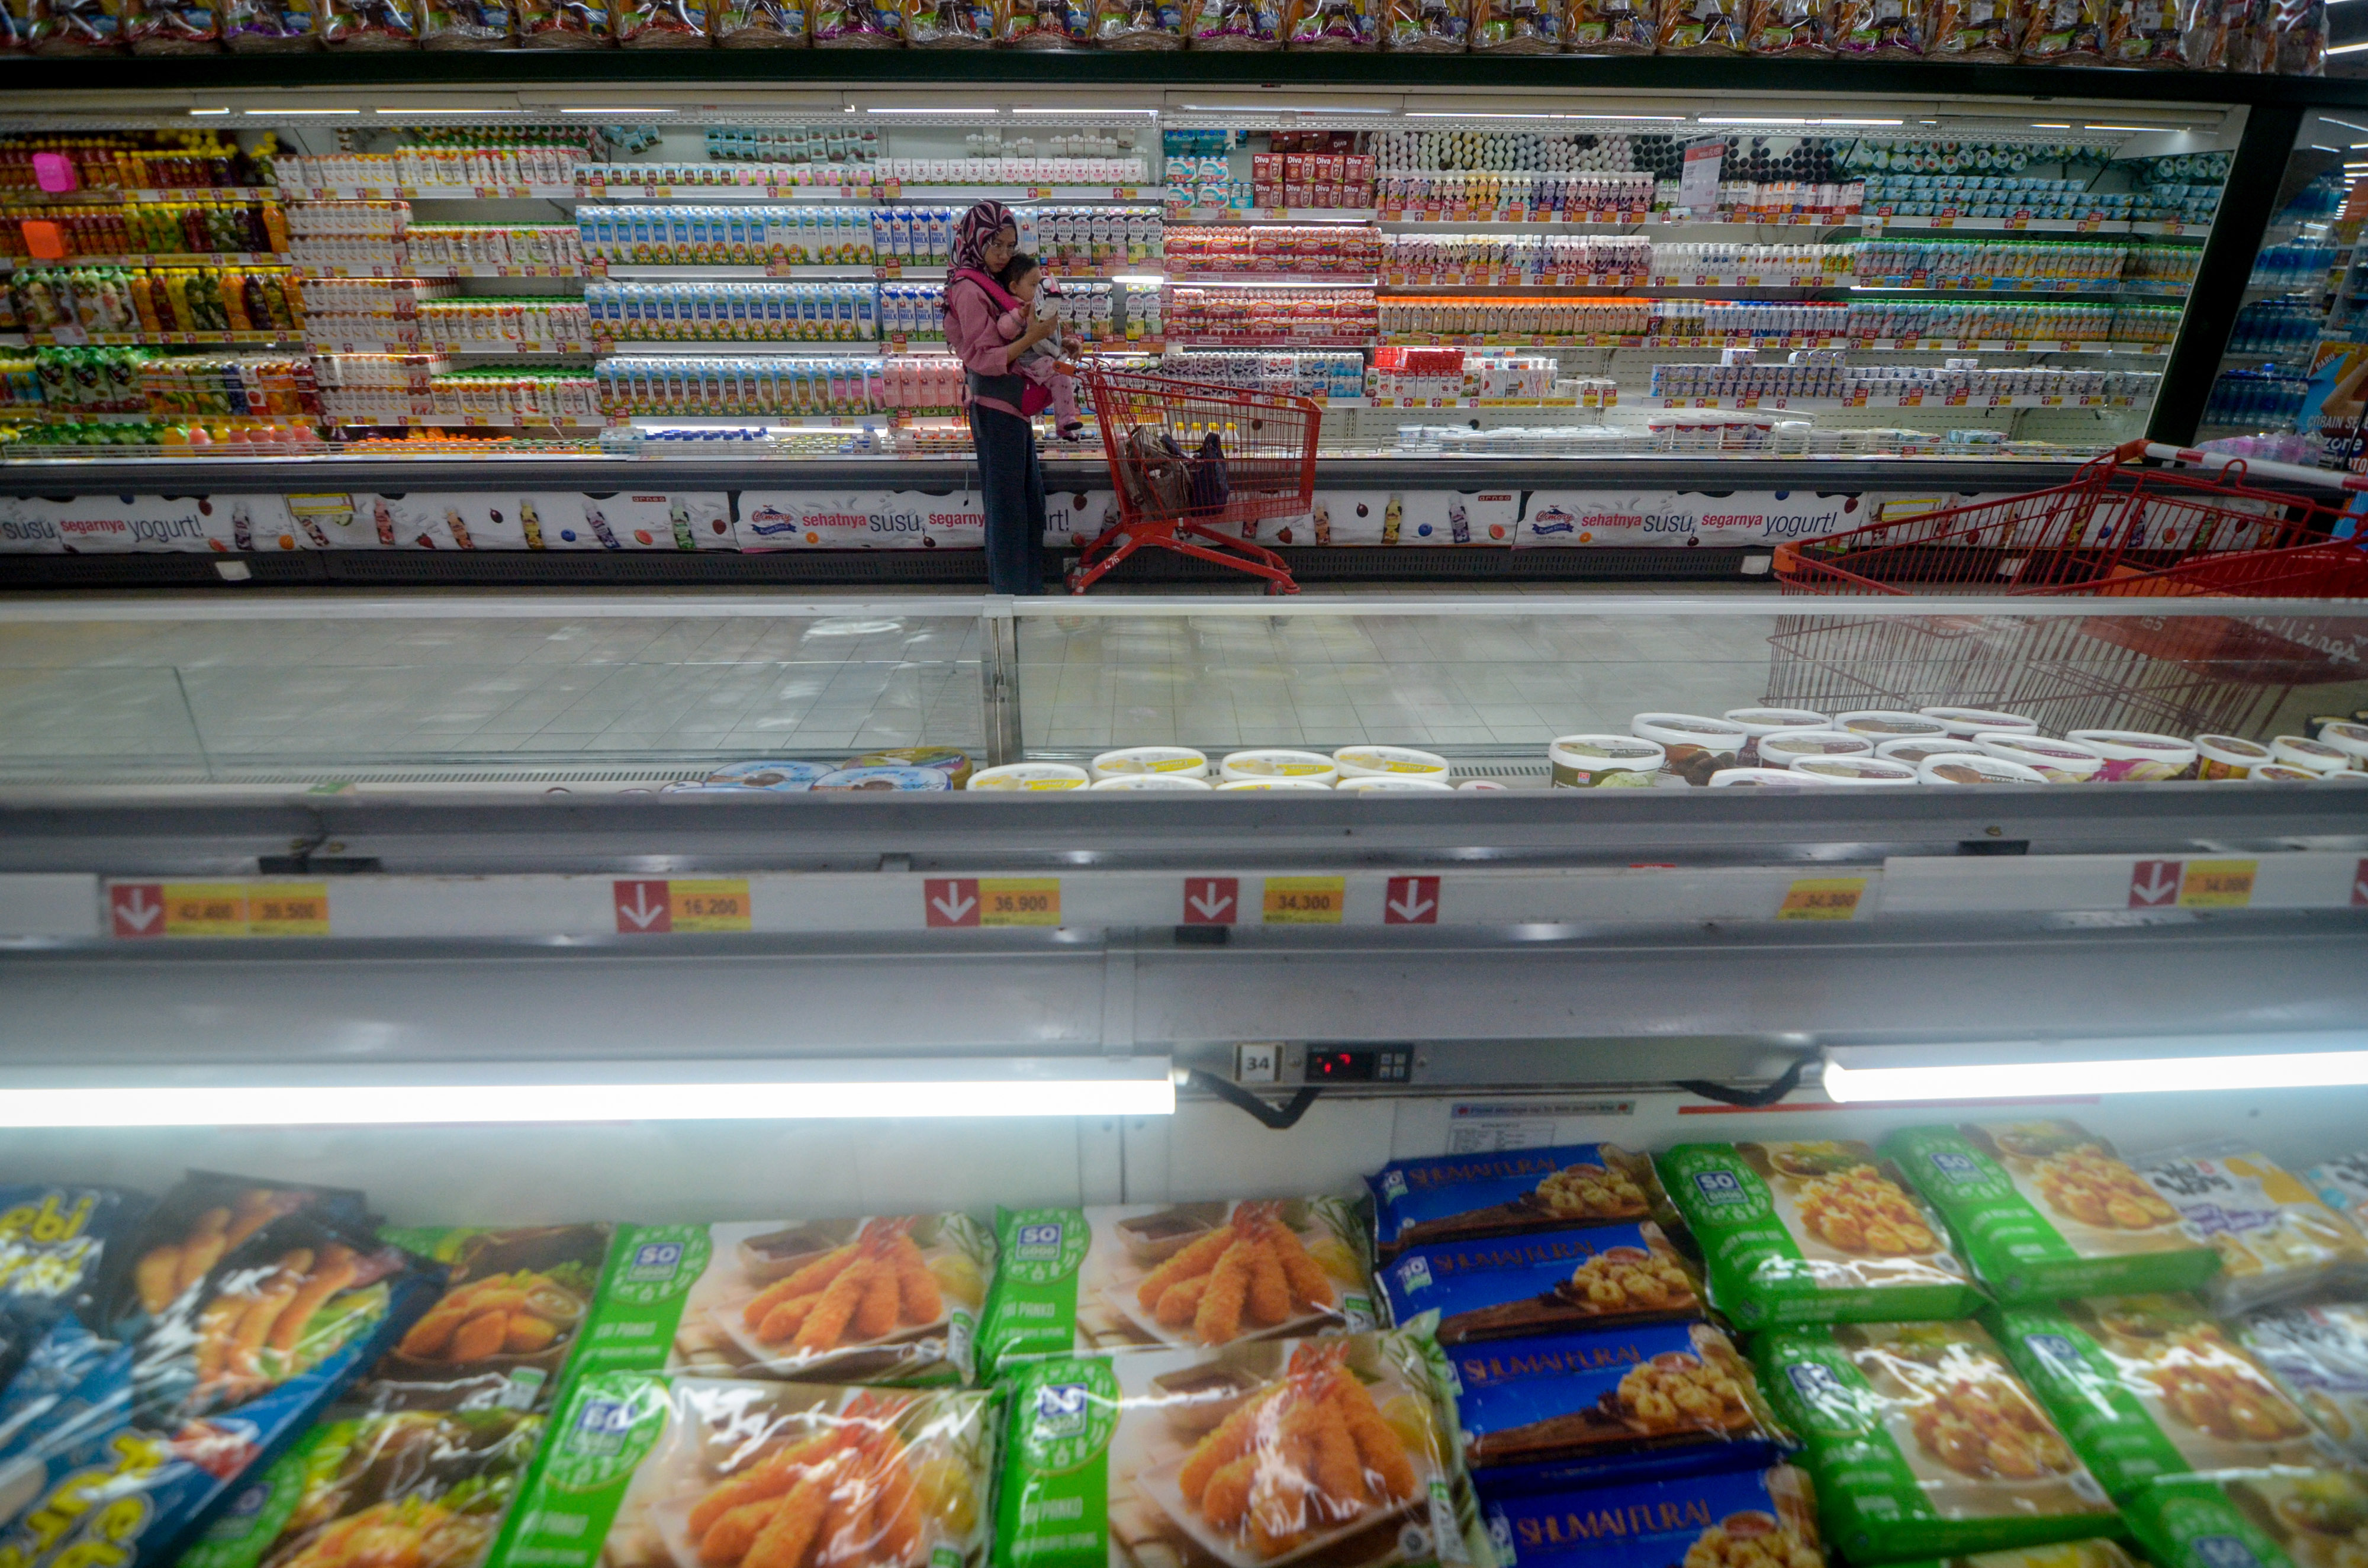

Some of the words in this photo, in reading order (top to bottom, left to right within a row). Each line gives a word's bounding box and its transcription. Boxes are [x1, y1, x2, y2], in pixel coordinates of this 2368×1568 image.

[2315, 353, 2335, 371] BARU
[2, 521, 62, 541] susu,
[60, 519, 126, 535] segarnya
[127, 514, 204, 543] yogurt!
[803, 512, 867, 532] sehatnya
[870, 513, 925, 533] susu,
[929, 510, 984, 527] segarny
[1582, 513, 1642, 529] sehatnya
[1643, 514, 1695, 533] susu,
[1701, 513, 1763, 529] segarnya
[1765, 511, 1836, 537] yogurt!
[1103, 555, 1120, 569] 476
[995, 894, 1048, 912] 36.900
[1246, 1056, 1270, 1071] 34
[1700, 1174, 1733, 1188] SO
[1022, 1225, 1060, 1243] SO
[632, 1247, 679, 1264] SO
